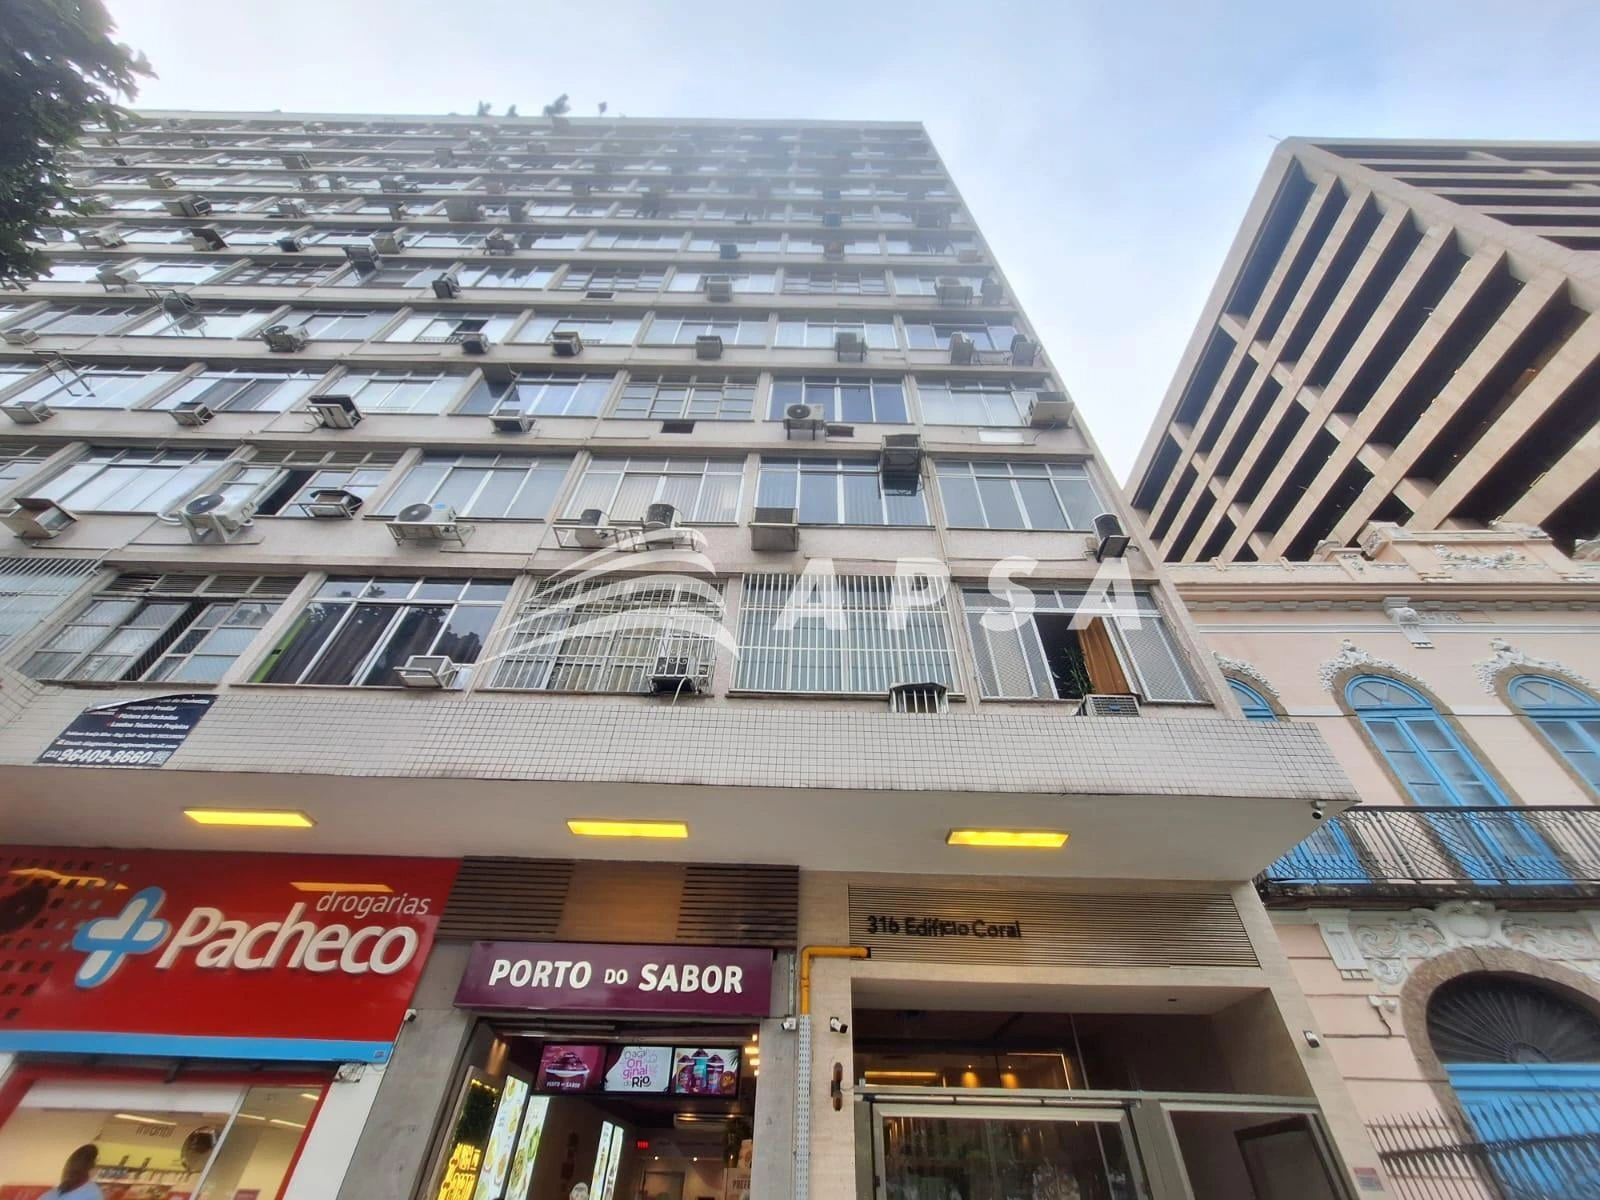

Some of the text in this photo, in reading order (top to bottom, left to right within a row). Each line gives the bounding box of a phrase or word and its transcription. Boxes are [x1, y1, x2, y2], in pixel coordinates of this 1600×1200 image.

[58, 748, 154, 764] 96409-8660
[315, 890, 432, 919] drogarias
[154, 902, 419, 975] Pacheco
[973, 919, 1022, 938] Coral
[488, 959, 743, 994] PORTO DO SABOR
